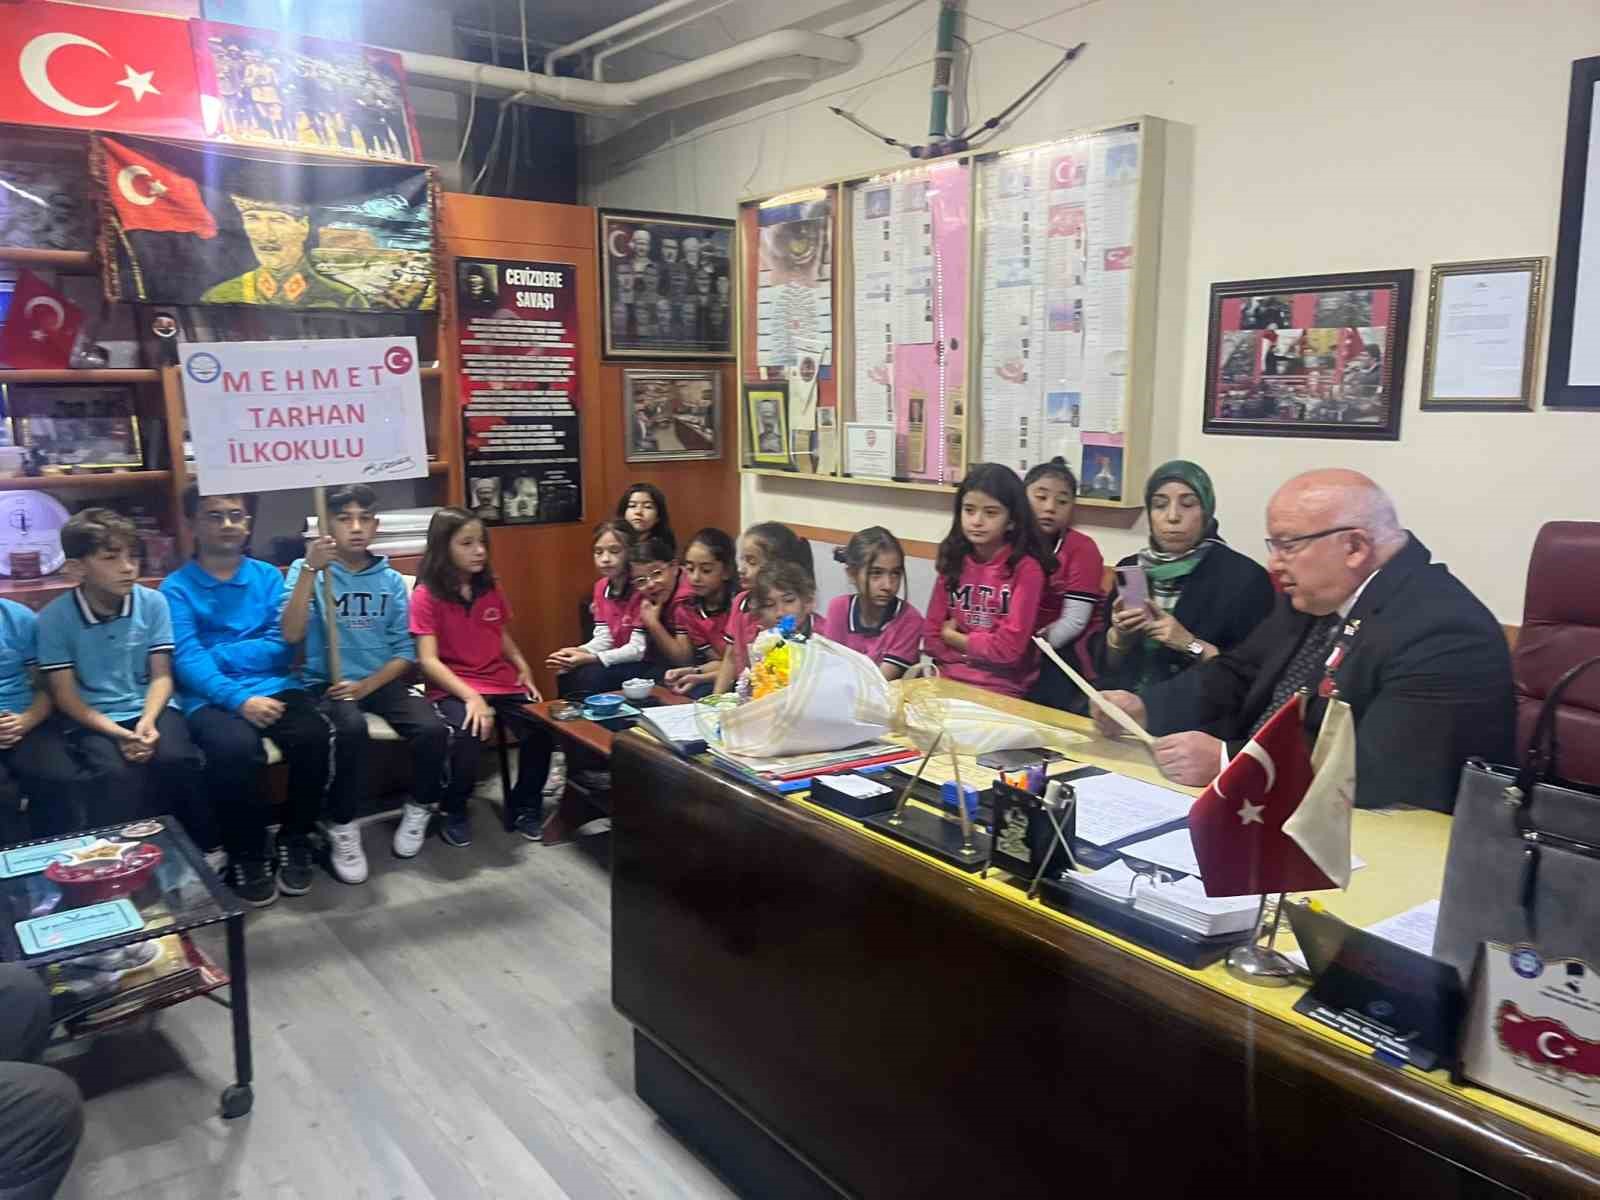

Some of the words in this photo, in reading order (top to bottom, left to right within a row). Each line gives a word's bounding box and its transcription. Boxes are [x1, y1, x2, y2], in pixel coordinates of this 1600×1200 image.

[505, 266, 563, 288] CEVİZDERE
[515, 291, 555, 311] SAVAŞI
[222, 365, 385, 393] MEHMET
[247, 403, 366, 428] TARHAN
[227, 437, 365, 464] İLKOKULU
